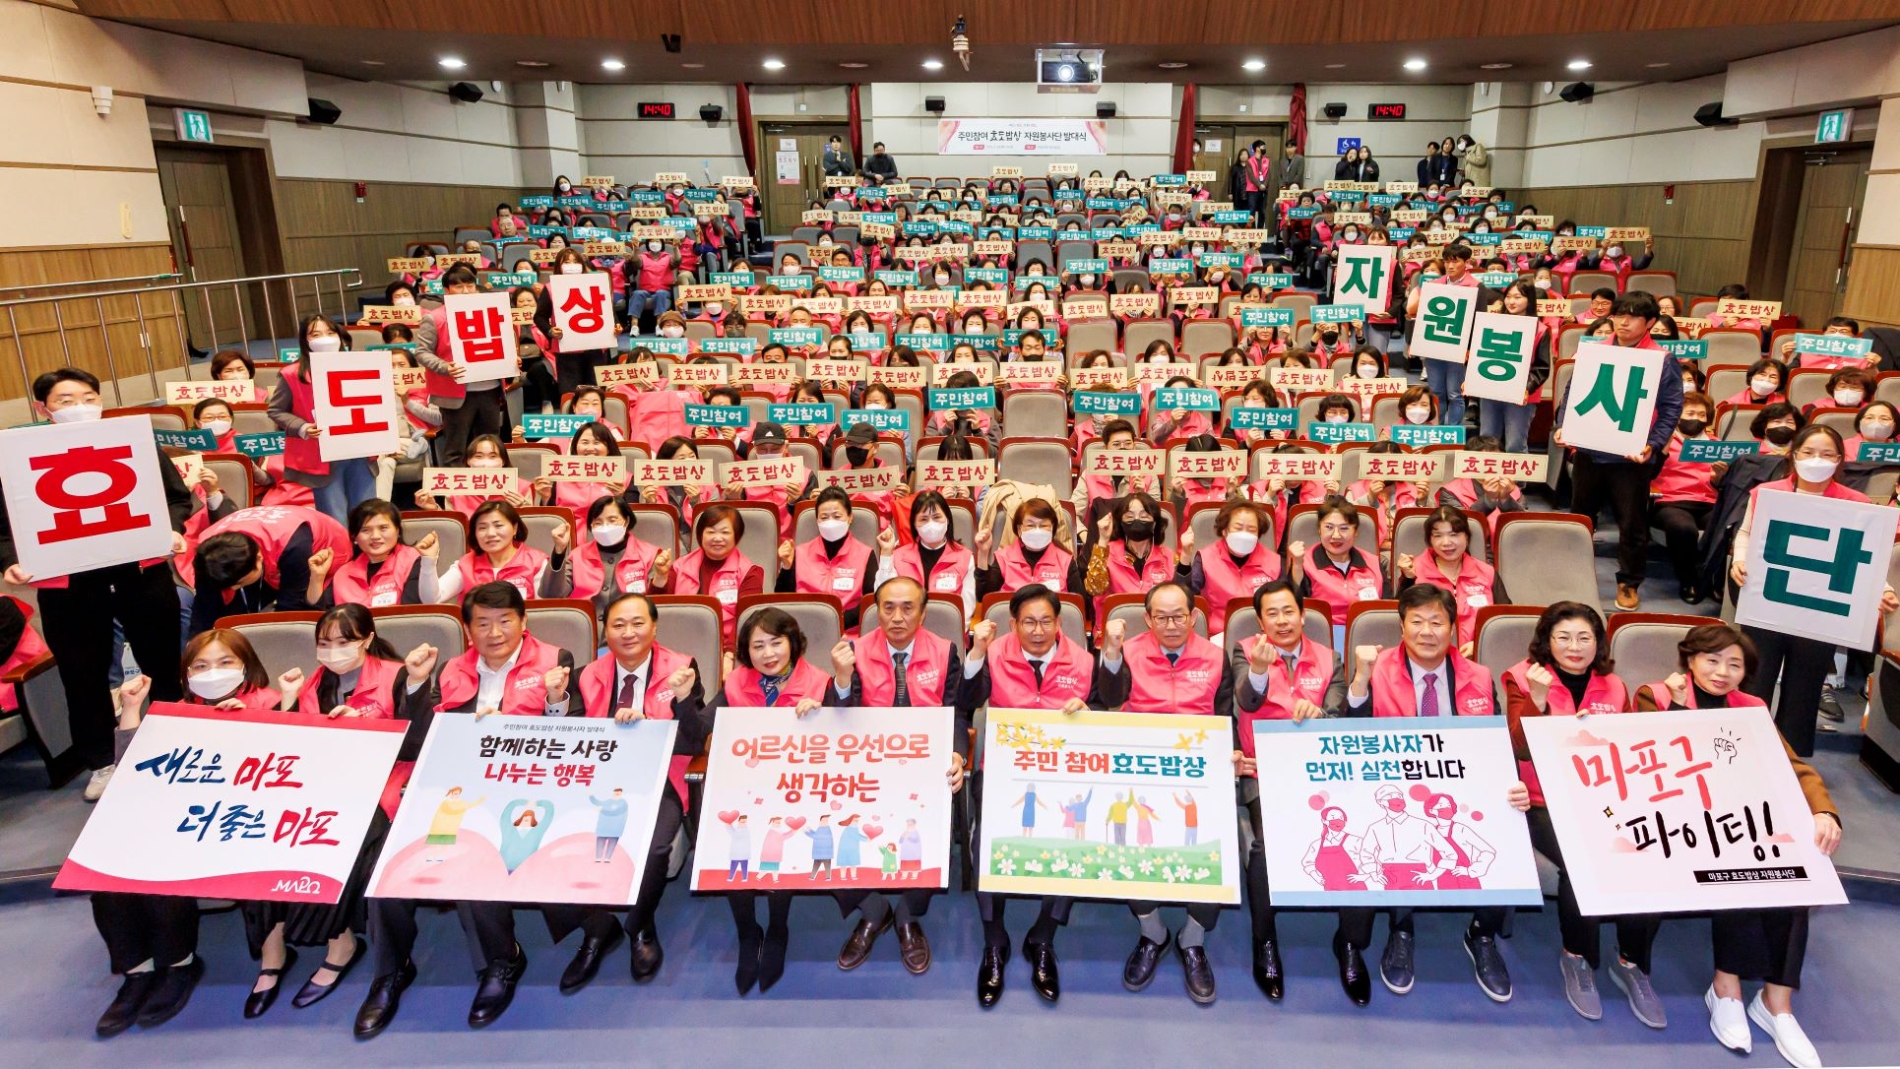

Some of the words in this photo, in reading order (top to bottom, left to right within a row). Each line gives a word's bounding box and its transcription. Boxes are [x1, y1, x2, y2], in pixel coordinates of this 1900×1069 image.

[644, 104, 671, 115] 14:40
[1376, 105, 1403, 116] 14:40
[958, 131, 988, 141] 주민참여
[990, 130, 1021, 142] 효도밥상
[1024, 131, 1062, 141] 자원봉사단
[1064, 131, 1087, 141] 발대식
[1372, 195, 1398, 203] 주민참여
[865, 214, 893, 222] 주민참여
[1337, 215, 1365, 223] 효도밥상
[1395, 212, 1424, 220] 효도밥상
[638, 228, 671, 237] 효도밥상
[864, 225, 892, 234] 효도밥상
[907, 223, 934, 231] 주민참여
[1021, 228, 1049, 237] 주민참여
[1129, 225, 1157, 235] 주민참여
[1059, 232, 1087, 240] 주민참여
[1145, 233, 1174, 242] 효도밥상
[1186, 229, 1217, 238] 효도밥상
[1389, 230, 1411, 238] 민참여
[1609, 230, 1645, 238] 효도밥상
[587, 244, 621, 252] 효도밥상
[977, 244, 1008, 252] 효도밥상
[1101, 245, 1132, 254] 효도밥상
[1559, 240, 1592, 248] 효도밥상
[899, 249, 929, 258] 효도밥상
[934, 247, 964, 255] 효도밥상
[1408, 251, 1440, 259] 효도밥상
[392, 261, 426, 270] 효도밥상
[1070, 261, 1105, 271] 주민참여
[1154, 261, 1189, 271] 주민참여
[1203, 255, 1239, 265] 주민참여
[823, 269, 860, 278] 주민참여
[879, 272, 914, 283] 주민참여
[968, 270, 1003, 280] 주민참여
[1340, 257, 1385, 299] 자
[491, 276, 532, 285] 주민참여
[713, 276, 750, 284] 주민참여
[771, 278, 807, 287] 주민참여
[1251, 277, 1287, 285] 주민참여
[684, 288, 726, 297] 효도밥상
[964, 293, 1002, 304] 효도밥상
[1175, 290, 1215, 300] 효도밥상
[746, 298, 785, 308] 효도밥상
[852, 299, 891, 310] 효도밥상
[910, 295, 948, 304] 효도밥상
[1114, 297, 1154, 307] 효도밥상
[368, 309, 415, 320] 효도밥상
[560, 286, 605, 334] 상
[1067, 304, 1103, 315] 효도밥상
[1316, 306, 1360, 318] 주민참여
[1537, 304, 1566, 313] 도밥상
[1723, 302, 1776, 317] 효도밥상
[1246, 311, 1289, 323] 주민참여
[1423, 295, 1468, 345] 원
[455, 307, 504, 363] 밥
[773, 331, 817, 343] 주민참여
[706, 343, 750, 352] 주민참여
[900, 337, 943, 347] 주민참여
[1801, 337, 1863, 354] 주민참여
[1476, 327, 1523, 382] 봉
[1663, 343, 1700, 355] 민참여
[601, 366, 651, 382] 효도밥상
[673, 368, 720, 381] 효도밥상
[739, 368, 790, 379] 효도밥상
[811, 363, 860, 377] 효도밥상
[1005, 366, 1056, 379] 효도밥상
[1212, 370, 1262, 382] 효도밥상
[873, 370, 920, 384] 효도밥상
[1075, 372, 1123, 385] 효도밥상
[1276, 373, 1329, 385] 효도밥상
[175, 385, 246, 399] 효도밥상
[1351, 383, 1401, 395] 효도밥상
[327, 369, 389, 436] 도
[934, 392, 988, 405] 주민참여
[1080, 396, 1134, 410] 주민참여
[1161, 392, 1214, 407] 주민참여
[1574, 363, 1649, 433] 사
[688, 407, 742, 422] 주민참여
[772, 406, 828, 420] 주민참여
[1238, 412, 1293, 426] 주민참여
[1315, 426, 1370, 441] 주민참여
[1398, 429, 1458, 444] 주민참여
[548, 460, 617, 477] 효도밥상
[1094, 454, 1158, 471] 효도밥상
[1177, 456, 1240, 473] 효도밥상
[1267, 459, 1335, 476] 효도밥상
[1366, 459, 1437, 476] 효도밥상
[1462, 456, 1539, 475] 효도밥상
[641, 464, 706, 480] 효도밥상
[728, 463, 796, 484] 효도밥상
[924, 464, 988, 482] 효도밥상
[431, 474, 509, 490] 효도밥상
[826, 472, 892, 489] 효도밥상
[29, 445, 152, 545] 효
[1761, 518, 1873, 618] 단
[479, 735, 566, 760] 함께하는
[571, 737, 618, 762] 사랑
[732, 734, 830, 764] 어르신을
[836, 734, 930, 763] 우선으로
[1318, 734, 1444, 755] 자원봉사자가
[1014, 751, 1058, 773] 주민
[135, 746, 226, 784] 새로운
[233, 752, 304, 791] 마포
[1306, 761, 1353, 782] 먼저!
[1361, 759, 1465, 781] 실천합니다
[1572, 735, 1712, 810] 마포구
[484, 763, 547, 785] 나누는
[553, 764, 596, 787] 행복
[777, 772, 880, 803] 생각하는
[177, 800, 222, 842] 더
[220, 804, 266, 841] 좋은
[273, 807, 340, 847] 마포
[1625, 801, 1781, 862] 파이팅!
[1708, 872, 1730, 881] 마포구
[1730, 871, 1760, 880] 효도밥상
[1760, 869, 1796, 879] 자원봉사단
